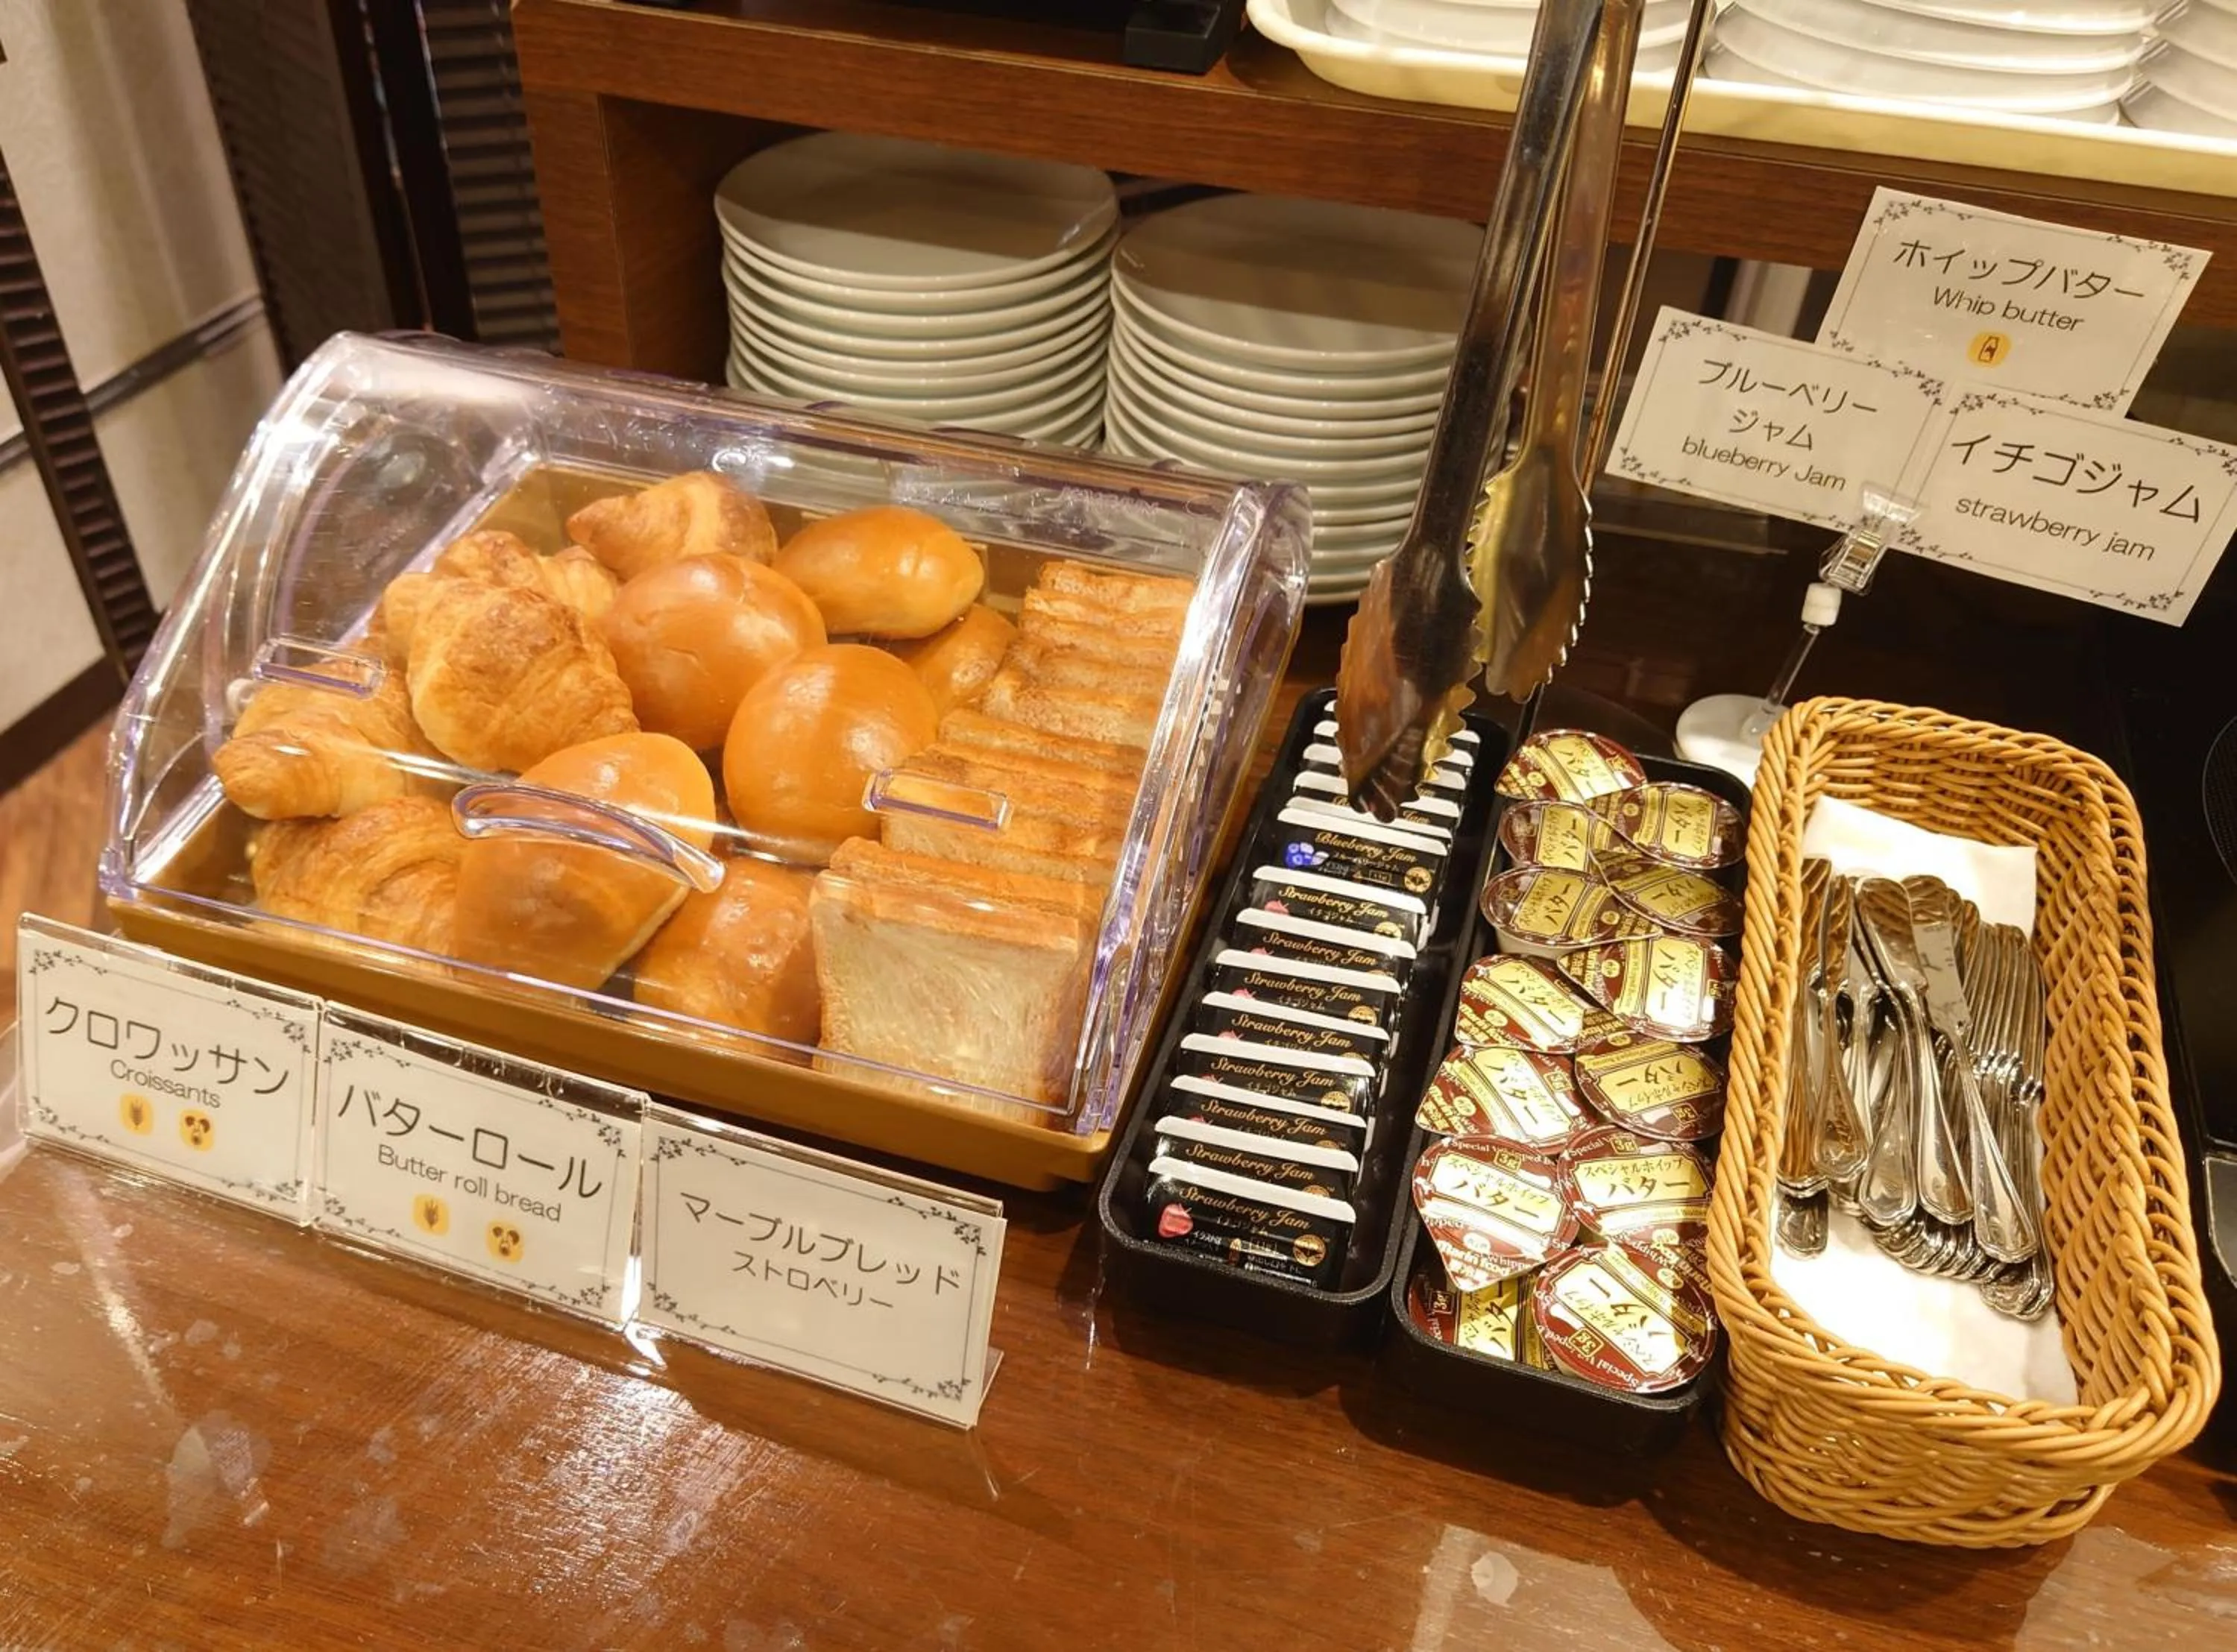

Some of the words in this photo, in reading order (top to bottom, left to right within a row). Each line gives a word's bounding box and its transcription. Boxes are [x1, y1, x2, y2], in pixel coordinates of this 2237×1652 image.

[1893, 240, 2145, 300] ホイップバター
[1932, 286, 1995, 318] Whip
[2003, 302, 2085, 332] butter
[1698, 359, 1878, 414] ブルーベリー
[1728, 409, 1813, 450] ジャム
[1681, 436, 1790, 478] blueberry
[1795, 463, 1846, 491] Jam
[1951, 434, 2202, 523] イチゴジャム
[1956, 495, 2100, 546] strawberry
[2101, 530, 2156, 562] jam
[1562, 819, 1582, 862] バター
[1670, 800, 1692, 843] バター
[1315, 831, 1383, 859] Blueberry
[1382, 847, 1418, 863] Jam
[1279, 886, 1355, 912] Strawberry
[1353, 901, 1388, 918] Jam
[1544, 883, 1570, 926] バター
[1262, 932, 1341, 961] Strawberry
[1341, 948, 1377, 966] Jam
[1244, 971, 1326, 999] Strawberry
[1325, 985, 1362, 1002] Jam
[1652, 948, 1678, 1012] バター
[1500, 979, 1565, 1025] バター
[45, 997, 290, 1096] クロワッサン
[1232, 1014, 1314, 1044] Strawberry
[1314, 1030, 1352, 1047] Jam
[110, 1059, 221, 1109] Croissants
[1210, 1057, 1297, 1085] Strawberry
[1296, 1071, 1335, 1088] Jam
[1485, 1064, 1538, 1124] バター
[1616, 1062, 1683, 1087] バター
[1201, 1099, 1288, 1131] Strawberry
[1287, 1117, 1326, 1135] Jam
[338, 1085, 602, 1199] バターロール
[1186, 1143, 1274, 1175] Strawberry
[1274, 1162, 1314, 1180] Jam
[1451, 1138, 1490, 1153] Special
[1499, 1153, 1519, 1170] 3g
[1569, 1139, 1605, 1156] Special
[1616, 1138, 1636, 1151] 3g
[378, 1144, 446, 1185] Butter
[454, 1174, 488, 1201] roll
[494, 1183, 562, 1223] bread
[1451, 1181, 1540, 1219] バター
[1608, 1176, 1690, 1199] バター
[1179, 1186, 1268, 1223] Strawberry
[1269, 1209, 1312, 1229] Jam
[680, 1191, 960, 1295] マーブルブレッド
[731, 1250, 893, 1309] ストロベリー
[1484, 1280, 1515, 1355] バター
[1588, 1276, 1670, 1339] バター
[1574, 1331, 1597, 1353] 3g
[1596, 1358, 1640, 1388] Special
